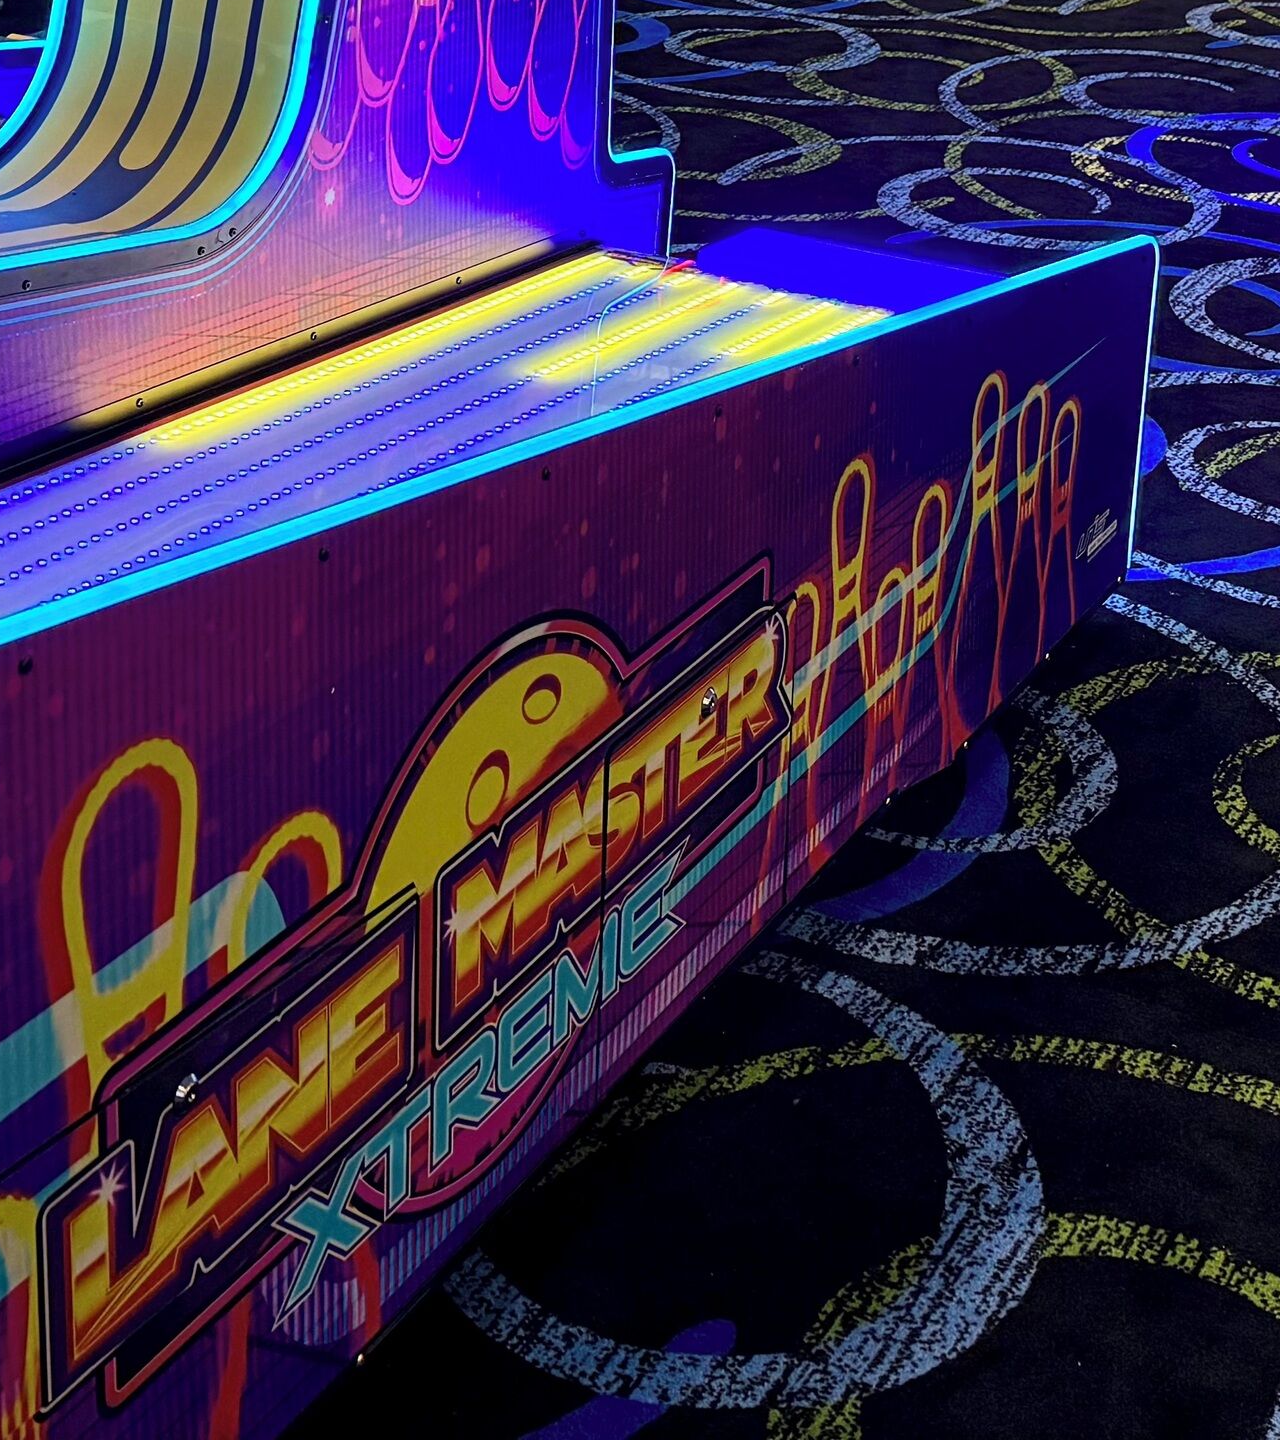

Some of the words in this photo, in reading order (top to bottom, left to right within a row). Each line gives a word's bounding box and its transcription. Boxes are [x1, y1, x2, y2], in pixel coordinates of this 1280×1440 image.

[66, 934, 410, 1363] LANE
[442, 621, 789, 1007] MASTER
[272, 841, 691, 1329] XTREME
